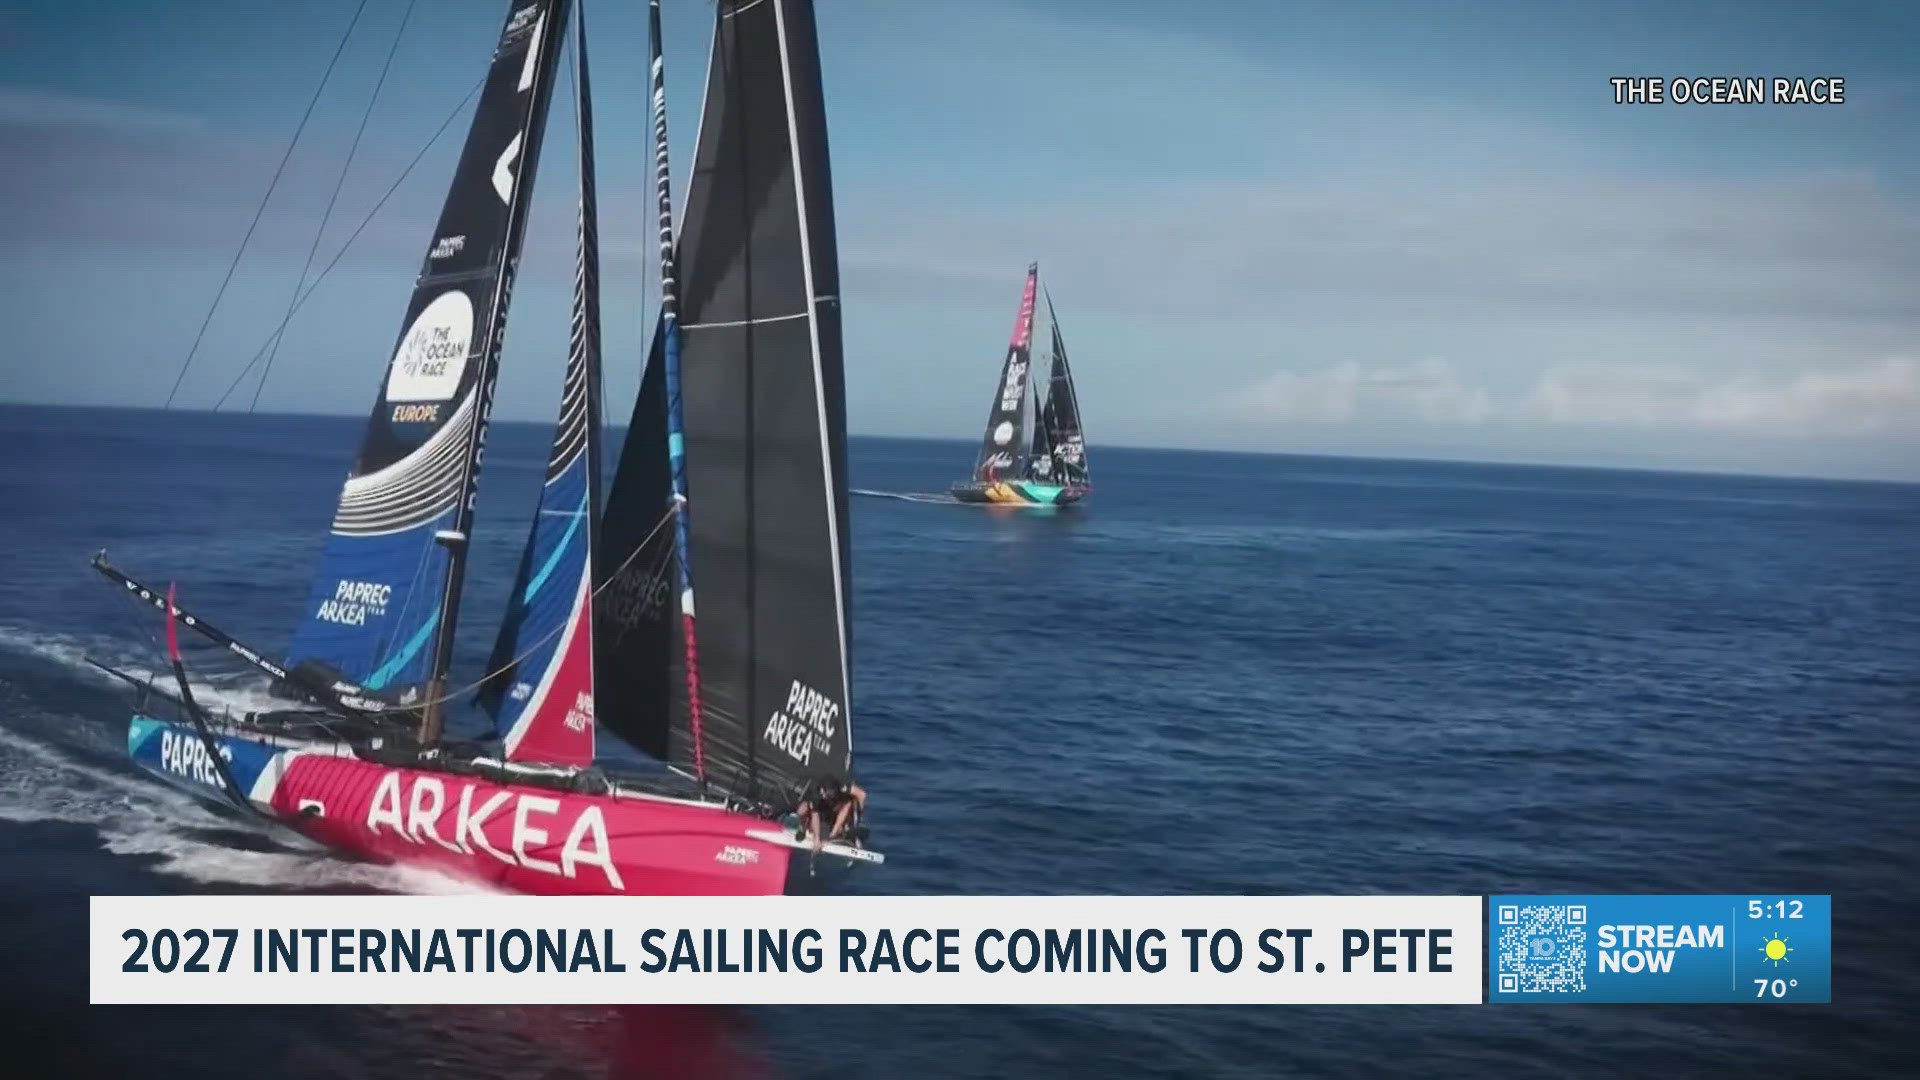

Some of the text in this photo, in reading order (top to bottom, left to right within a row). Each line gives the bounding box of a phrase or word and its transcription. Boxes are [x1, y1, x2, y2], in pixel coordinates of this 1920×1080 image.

[434, 327, 451, 340] THE
[427, 343, 464, 359] OCEAN
[421, 361, 447, 376] RACE
[392, 405, 439, 422] EUROPE
[335, 580, 392, 605] PAPREC
[316, 600, 366, 626] ARKEA
[786, 680, 838, 738] PAPREC
[764, 711, 813, 766] ARKEA
[367, 771, 625, 890] ARKEA
